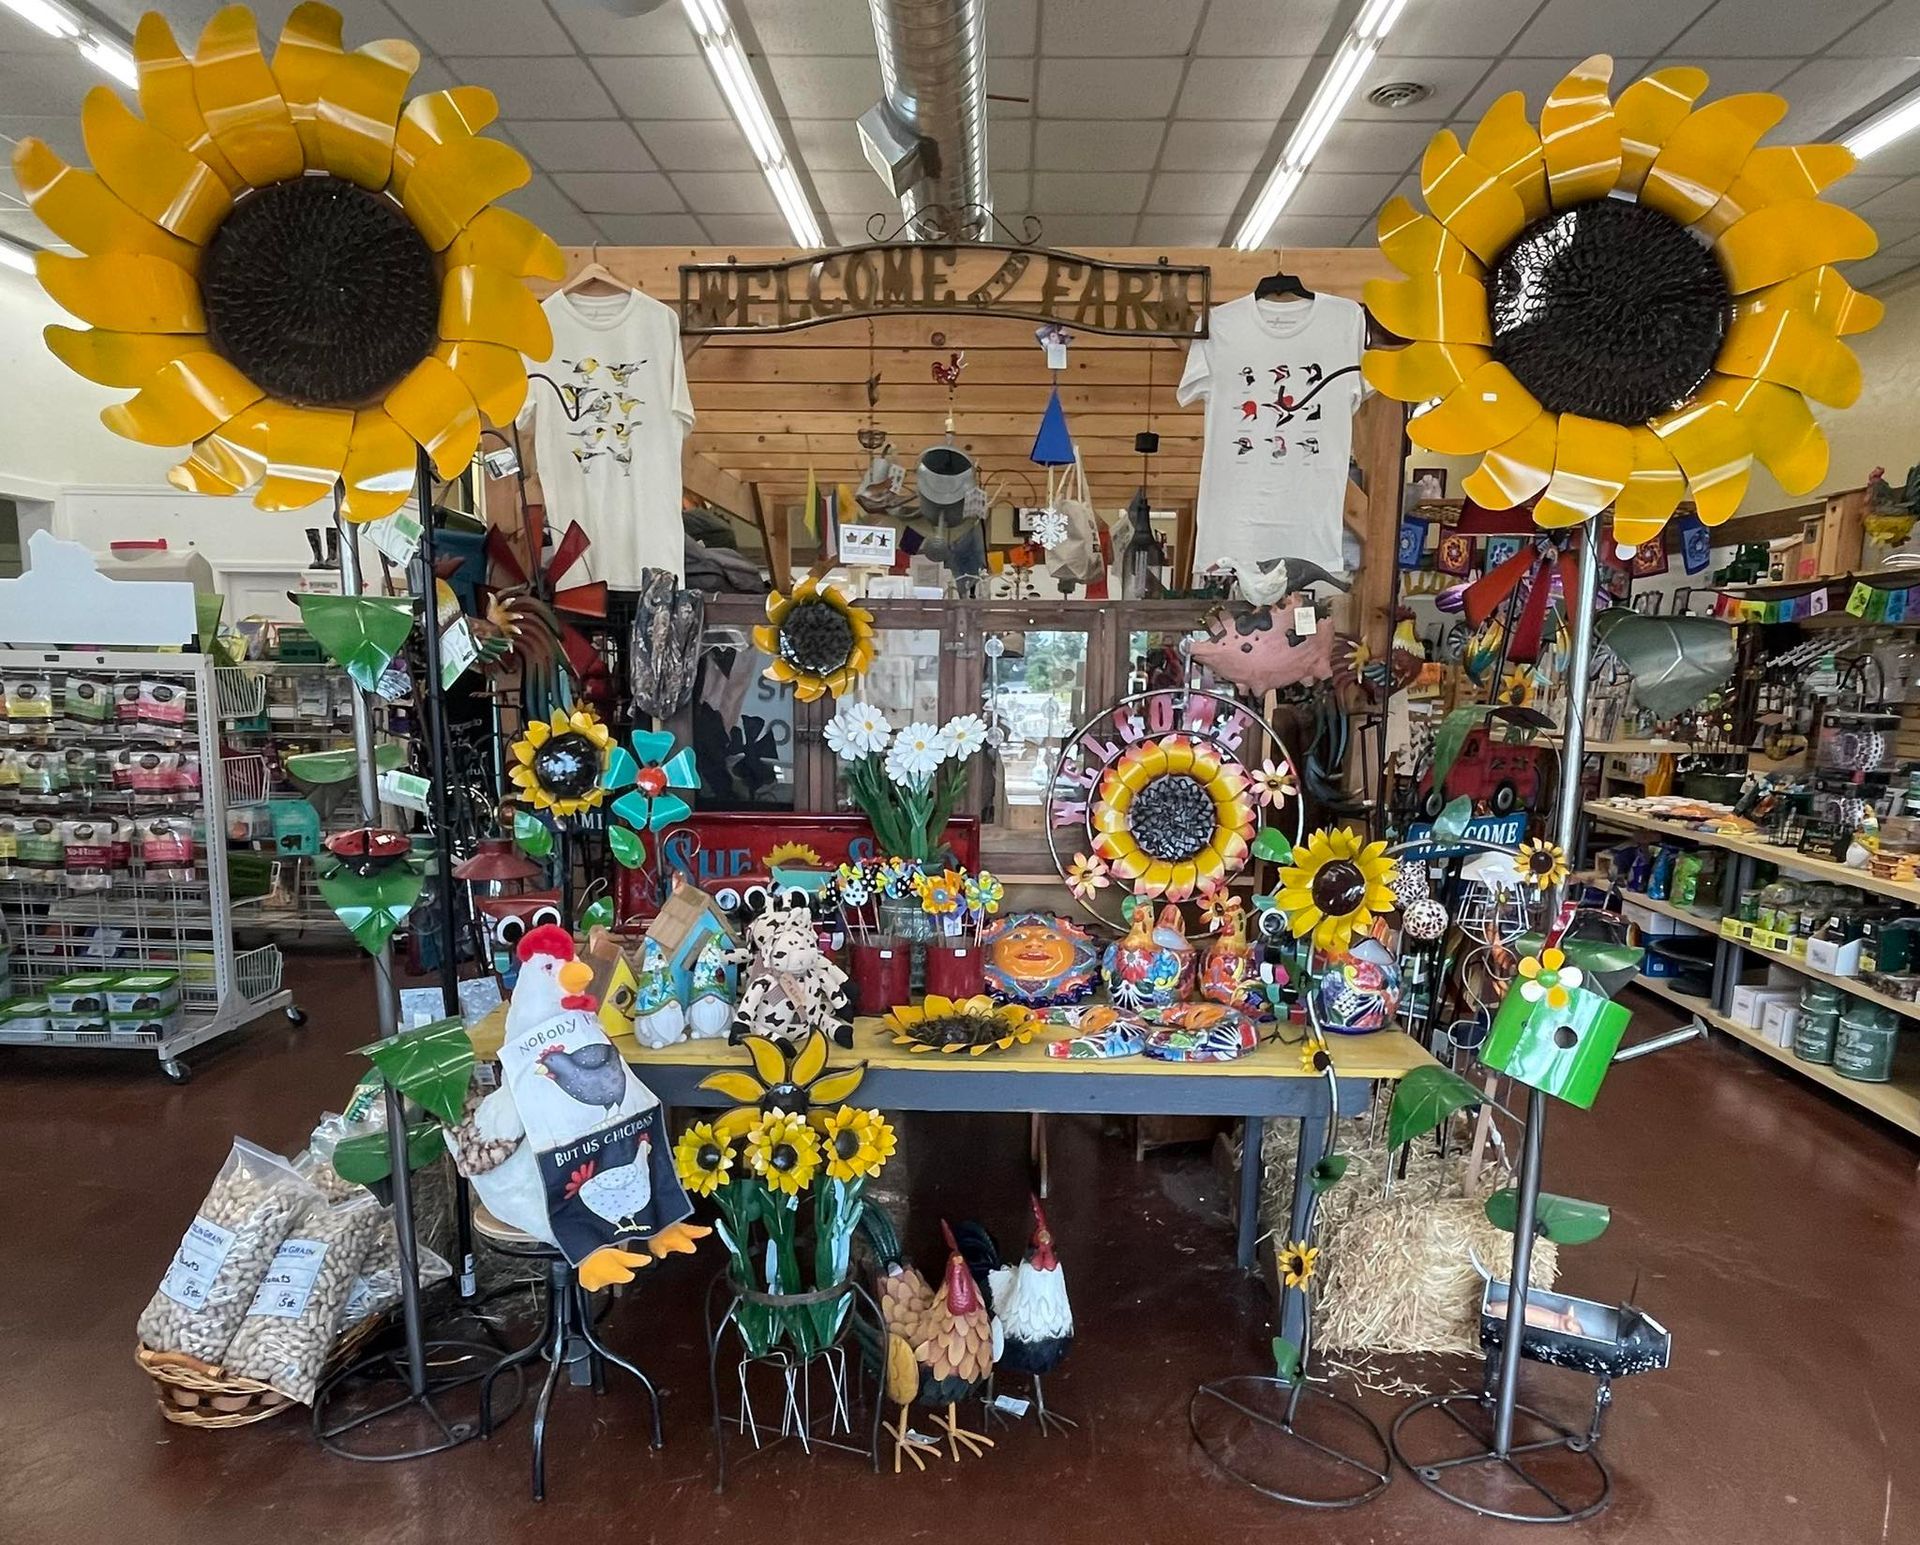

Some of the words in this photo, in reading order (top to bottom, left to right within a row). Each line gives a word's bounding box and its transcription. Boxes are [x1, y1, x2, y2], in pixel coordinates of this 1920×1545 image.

[699, 246, 957, 328] WELCOME
[1041, 256, 1192, 332] FARM
[1052, 692, 1251, 830] WELCOME
[1418, 822, 1518, 853] WCOME
[519, 1018, 576, 1056] NOBODY
[554, 1146, 579, 1168] BUT
[582, 1138, 600, 1155] US
[604, 1112, 654, 1145] CHICKENS
